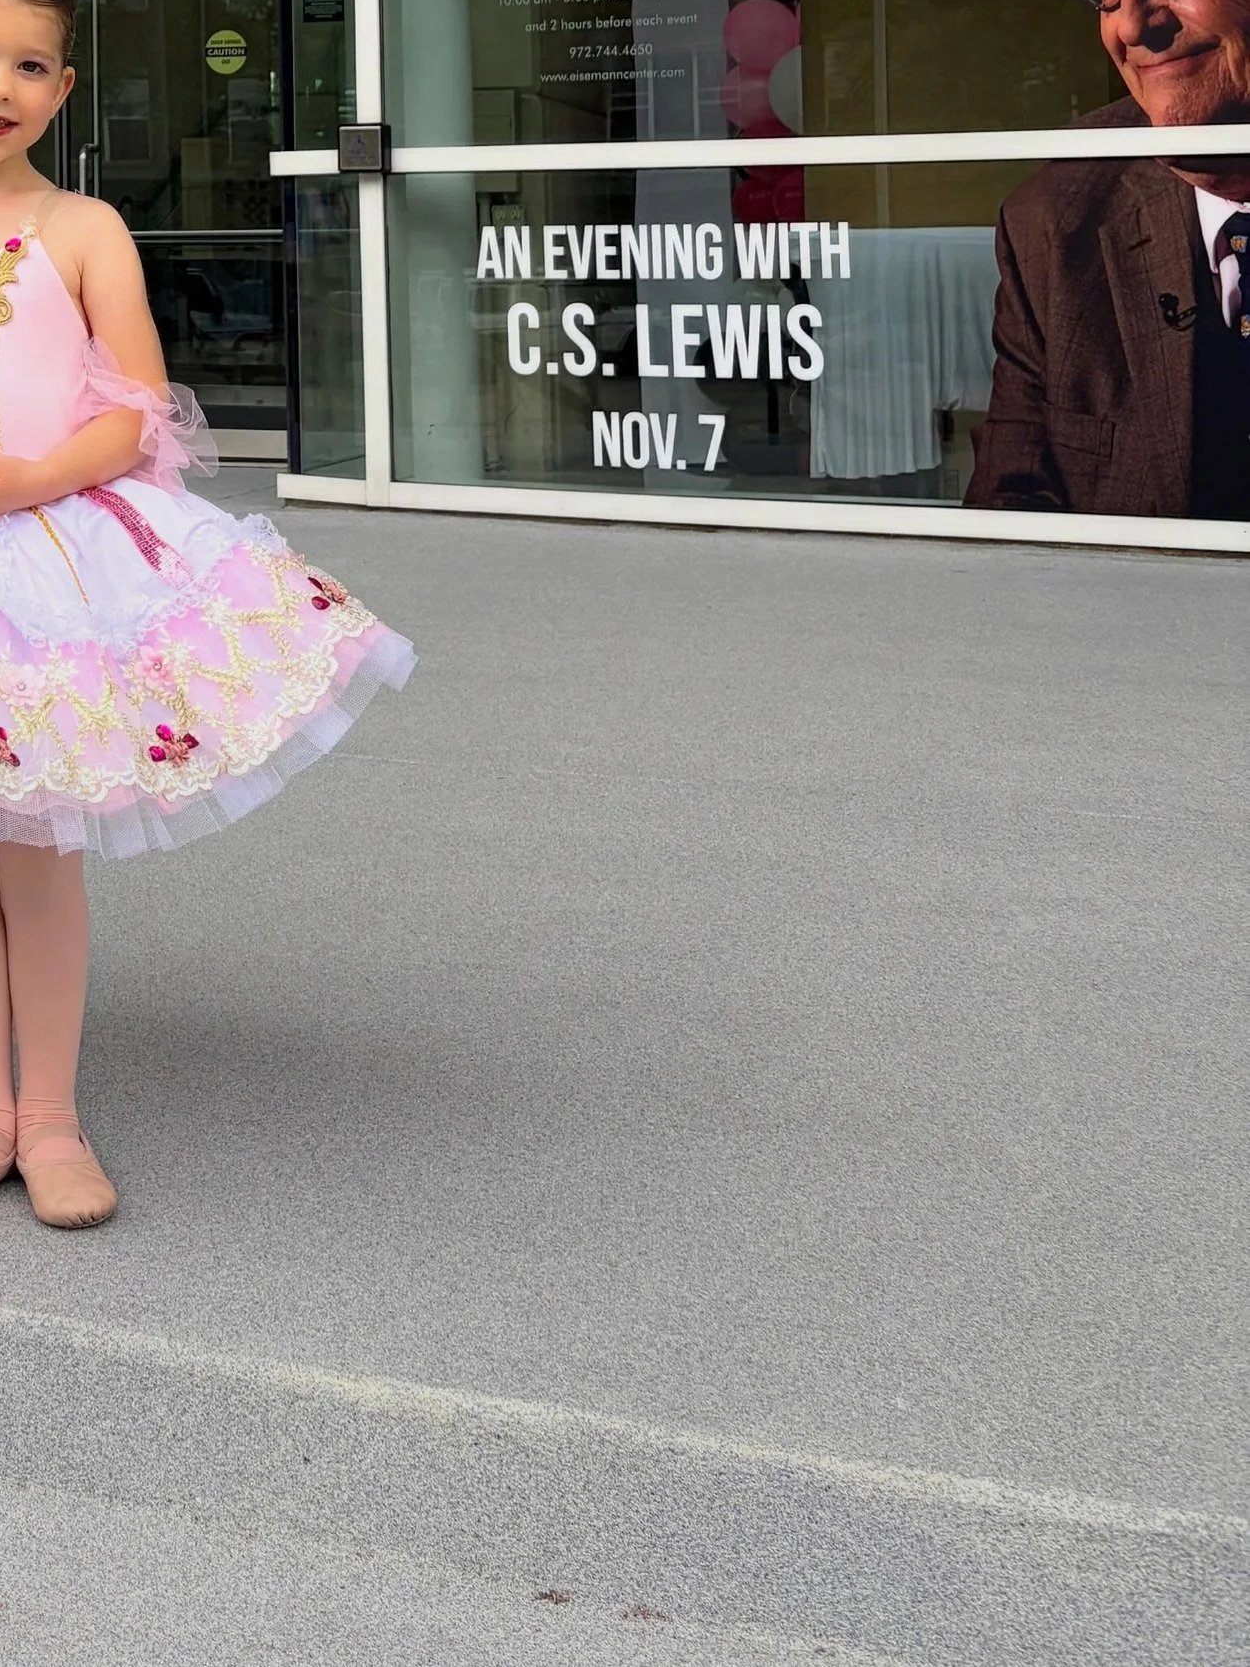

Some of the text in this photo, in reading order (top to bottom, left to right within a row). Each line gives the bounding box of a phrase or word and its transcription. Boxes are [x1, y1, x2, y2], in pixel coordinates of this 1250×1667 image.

[525, 13, 698, 32] and 2 hours before each event
[207, 47, 246, 56] CAUTION
[569, 43, 654, 59] 972.744.4650
[540, 68, 685, 83] www.eisemanncenter.com
[476, 221, 851, 280] AN EVENING WITH
[506, 302, 825, 382] C.S. LEWIS
[592, 410, 726, 472] NOV. 7
